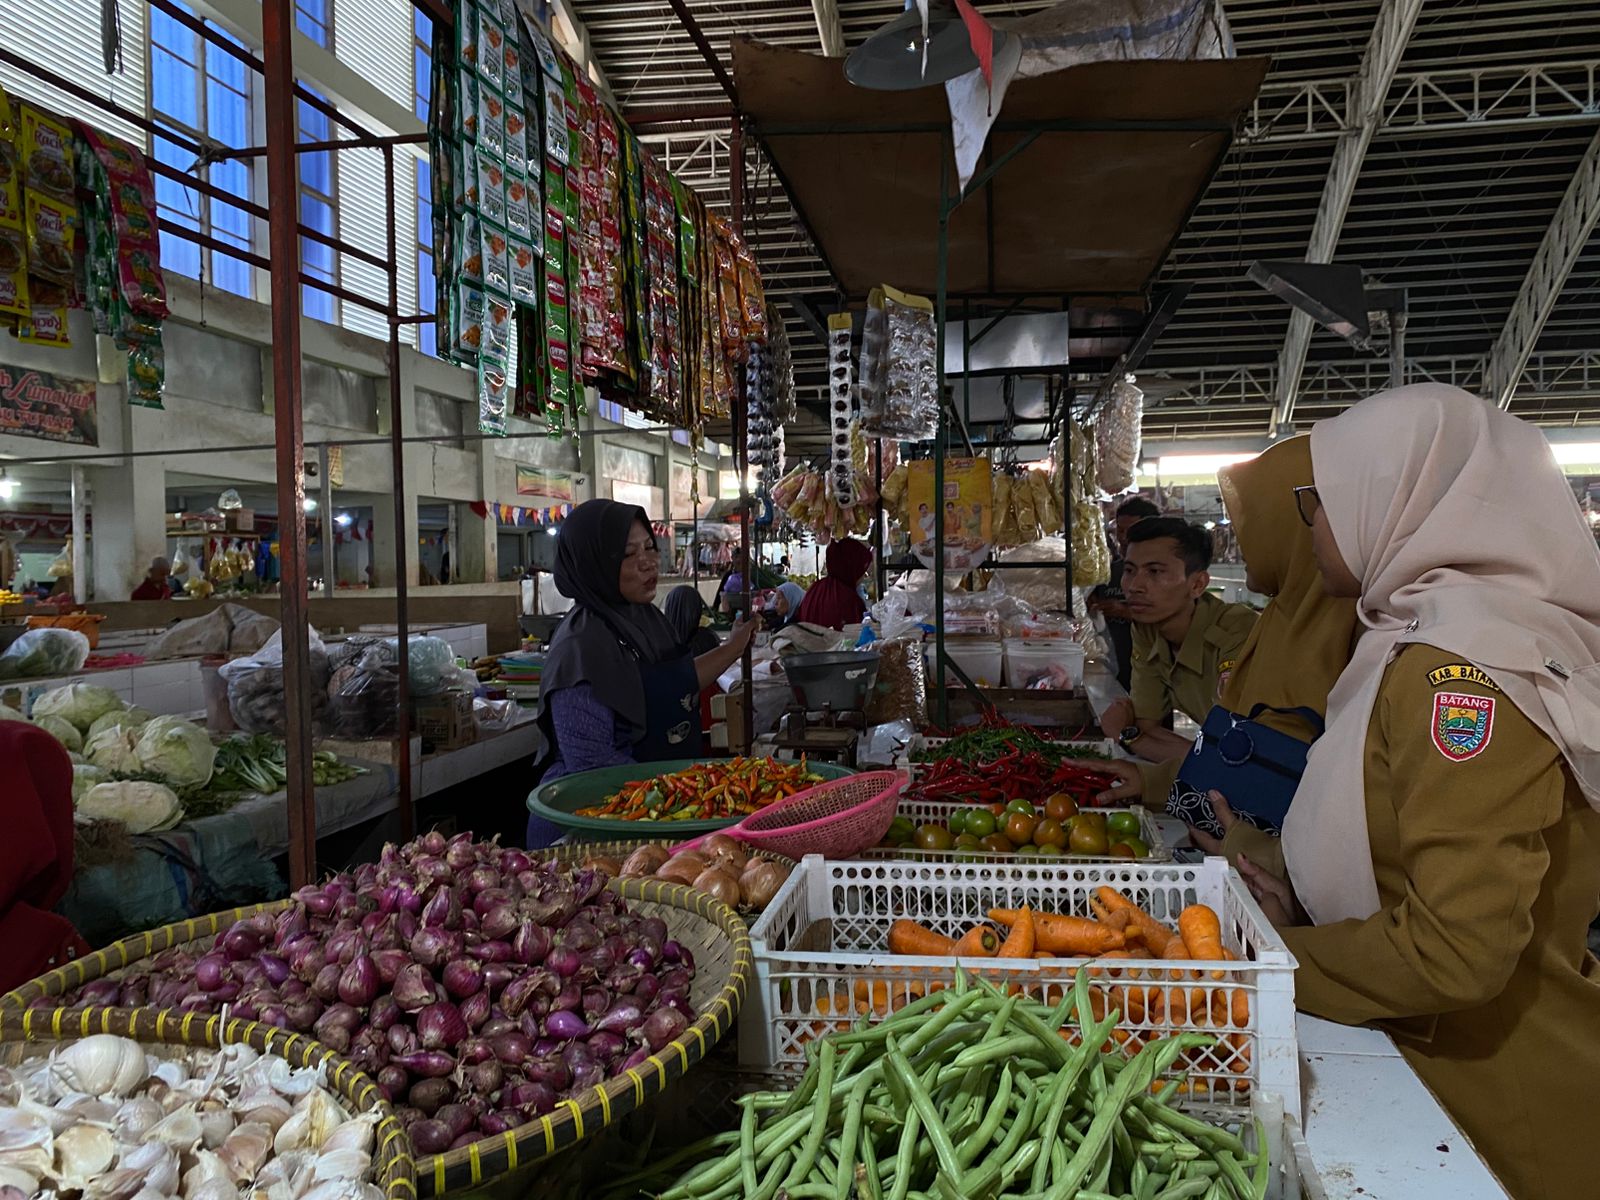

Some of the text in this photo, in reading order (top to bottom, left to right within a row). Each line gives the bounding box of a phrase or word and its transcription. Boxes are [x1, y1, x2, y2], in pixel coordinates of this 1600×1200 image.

[35, 212, 65, 232] Racik
[1431, 667, 1499, 690] KAB. BATAN
[1440, 695, 1489, 709] BATANG
